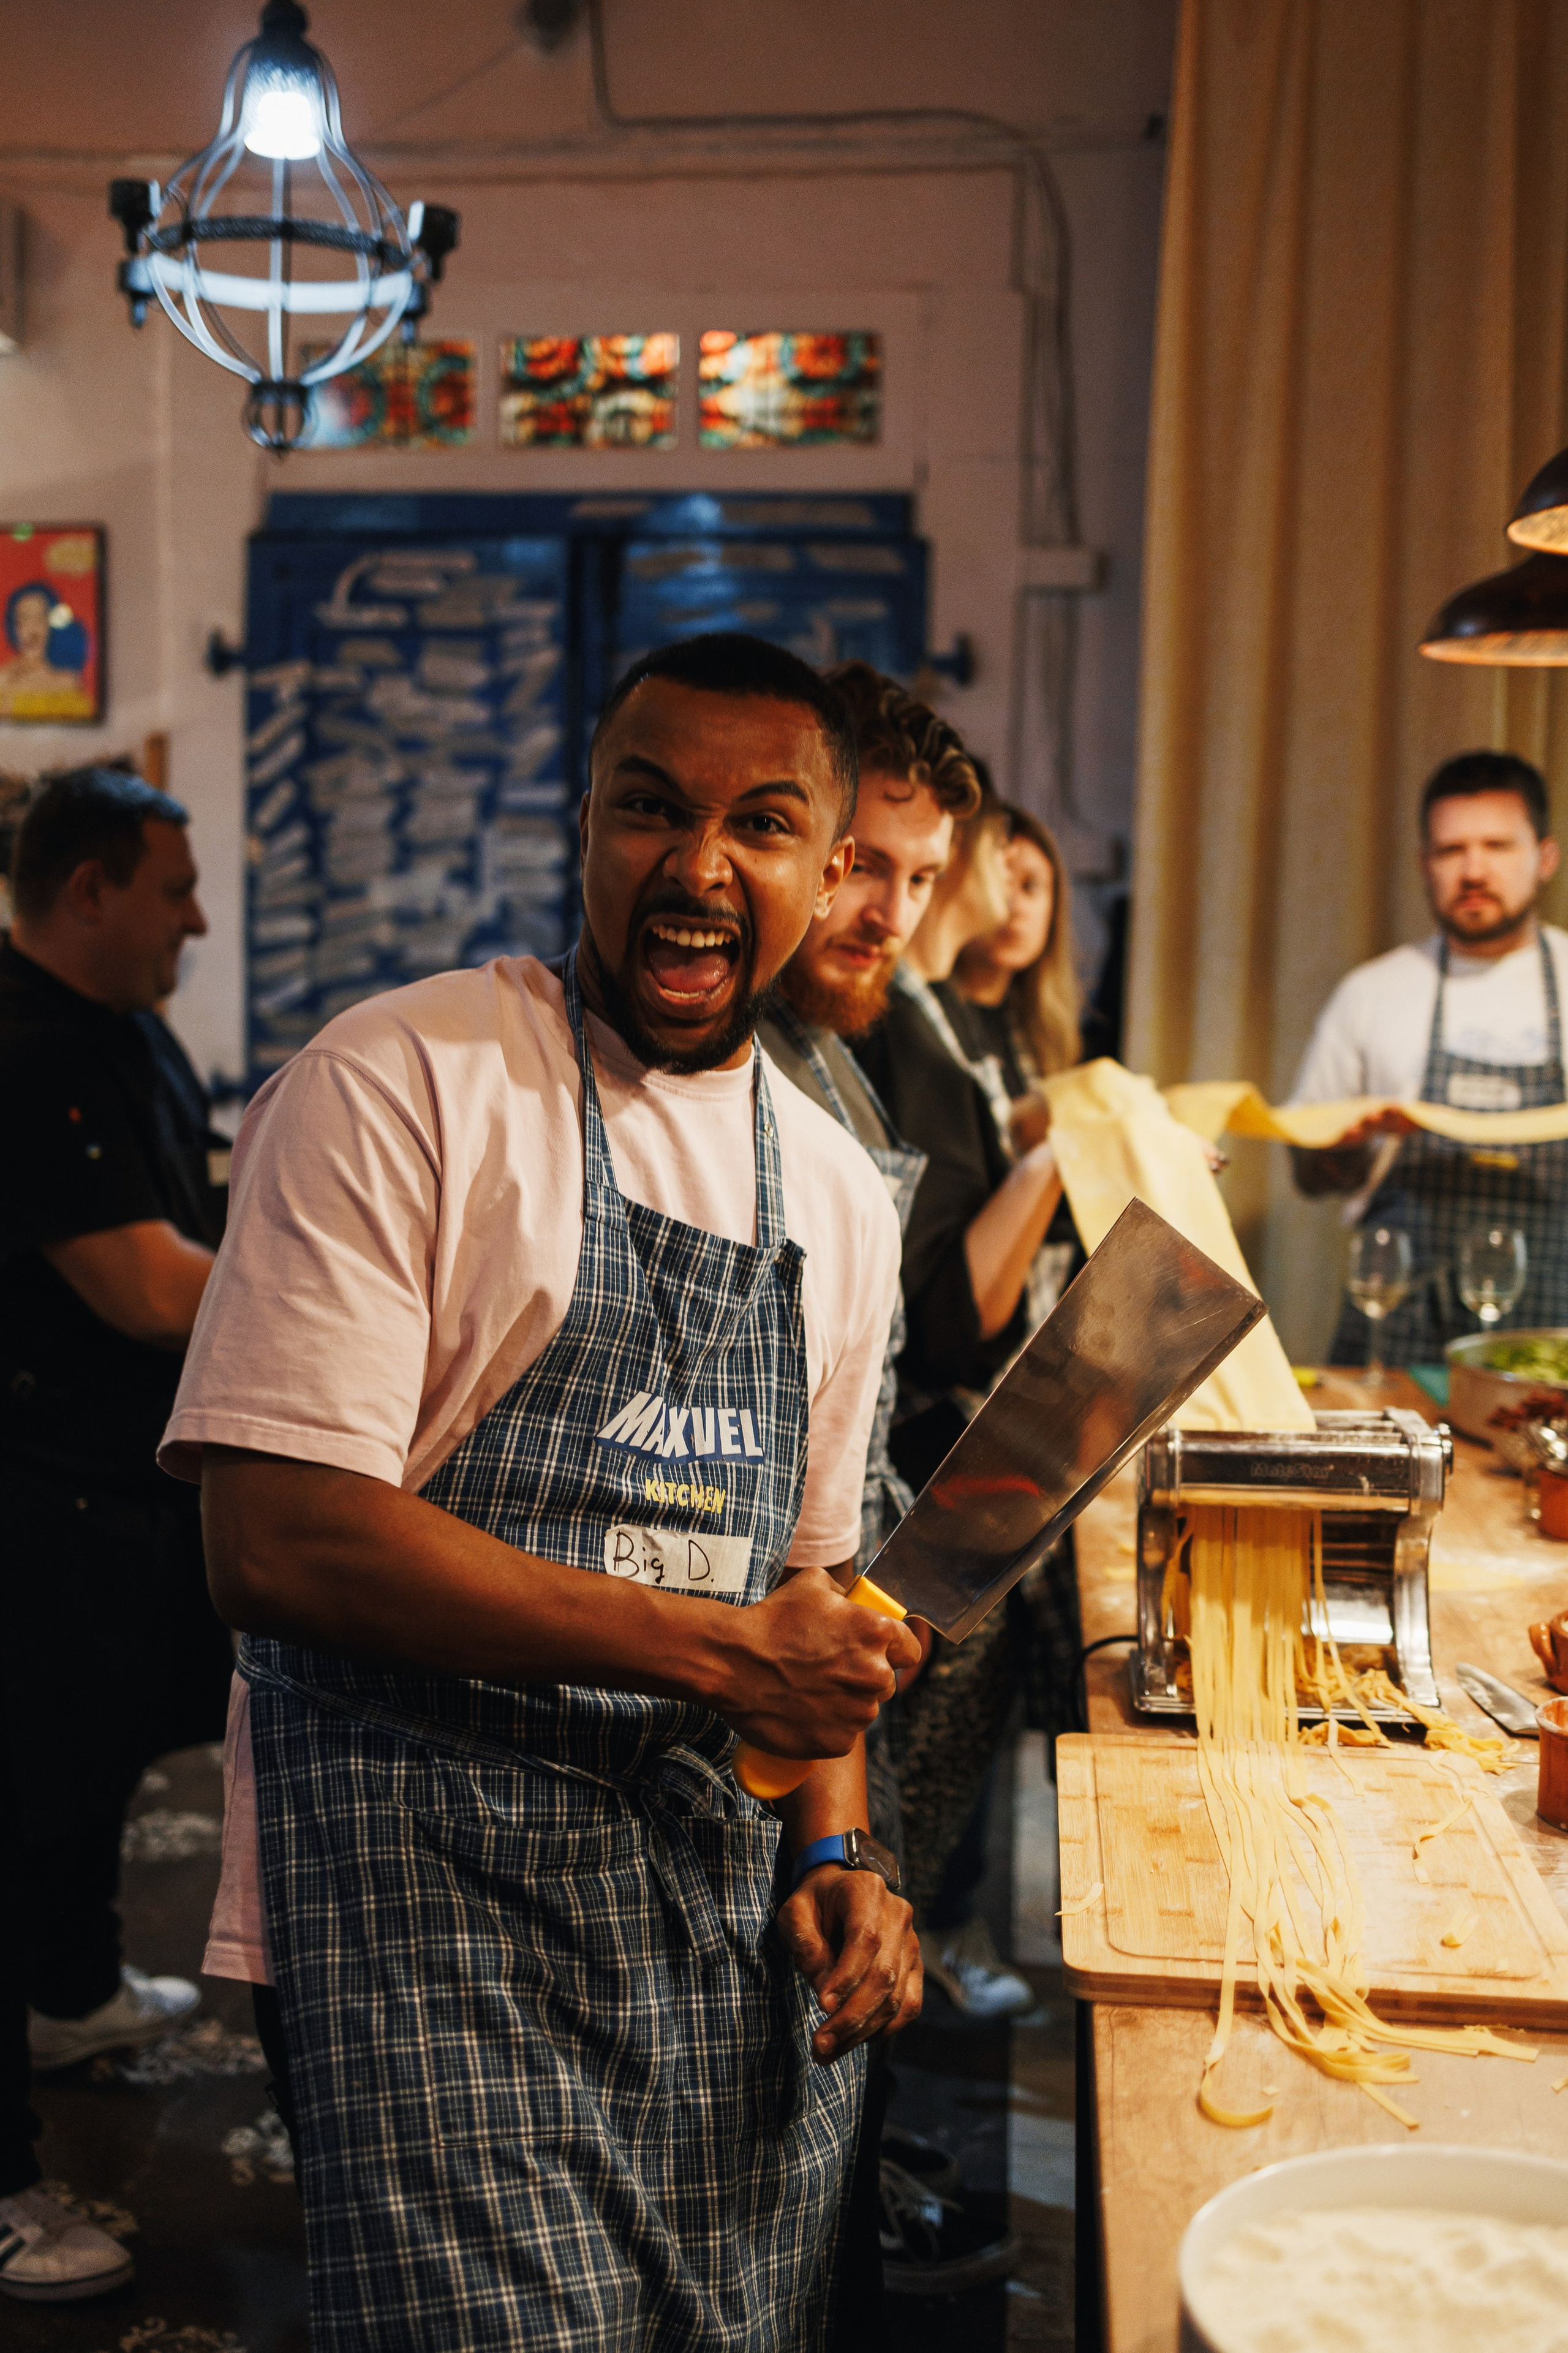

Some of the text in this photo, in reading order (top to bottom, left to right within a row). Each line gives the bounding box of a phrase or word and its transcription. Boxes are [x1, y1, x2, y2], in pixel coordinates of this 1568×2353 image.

[645, 1478, 726, 1514] KITCHEN
[613, 1531, 715, 1584] Big D.
